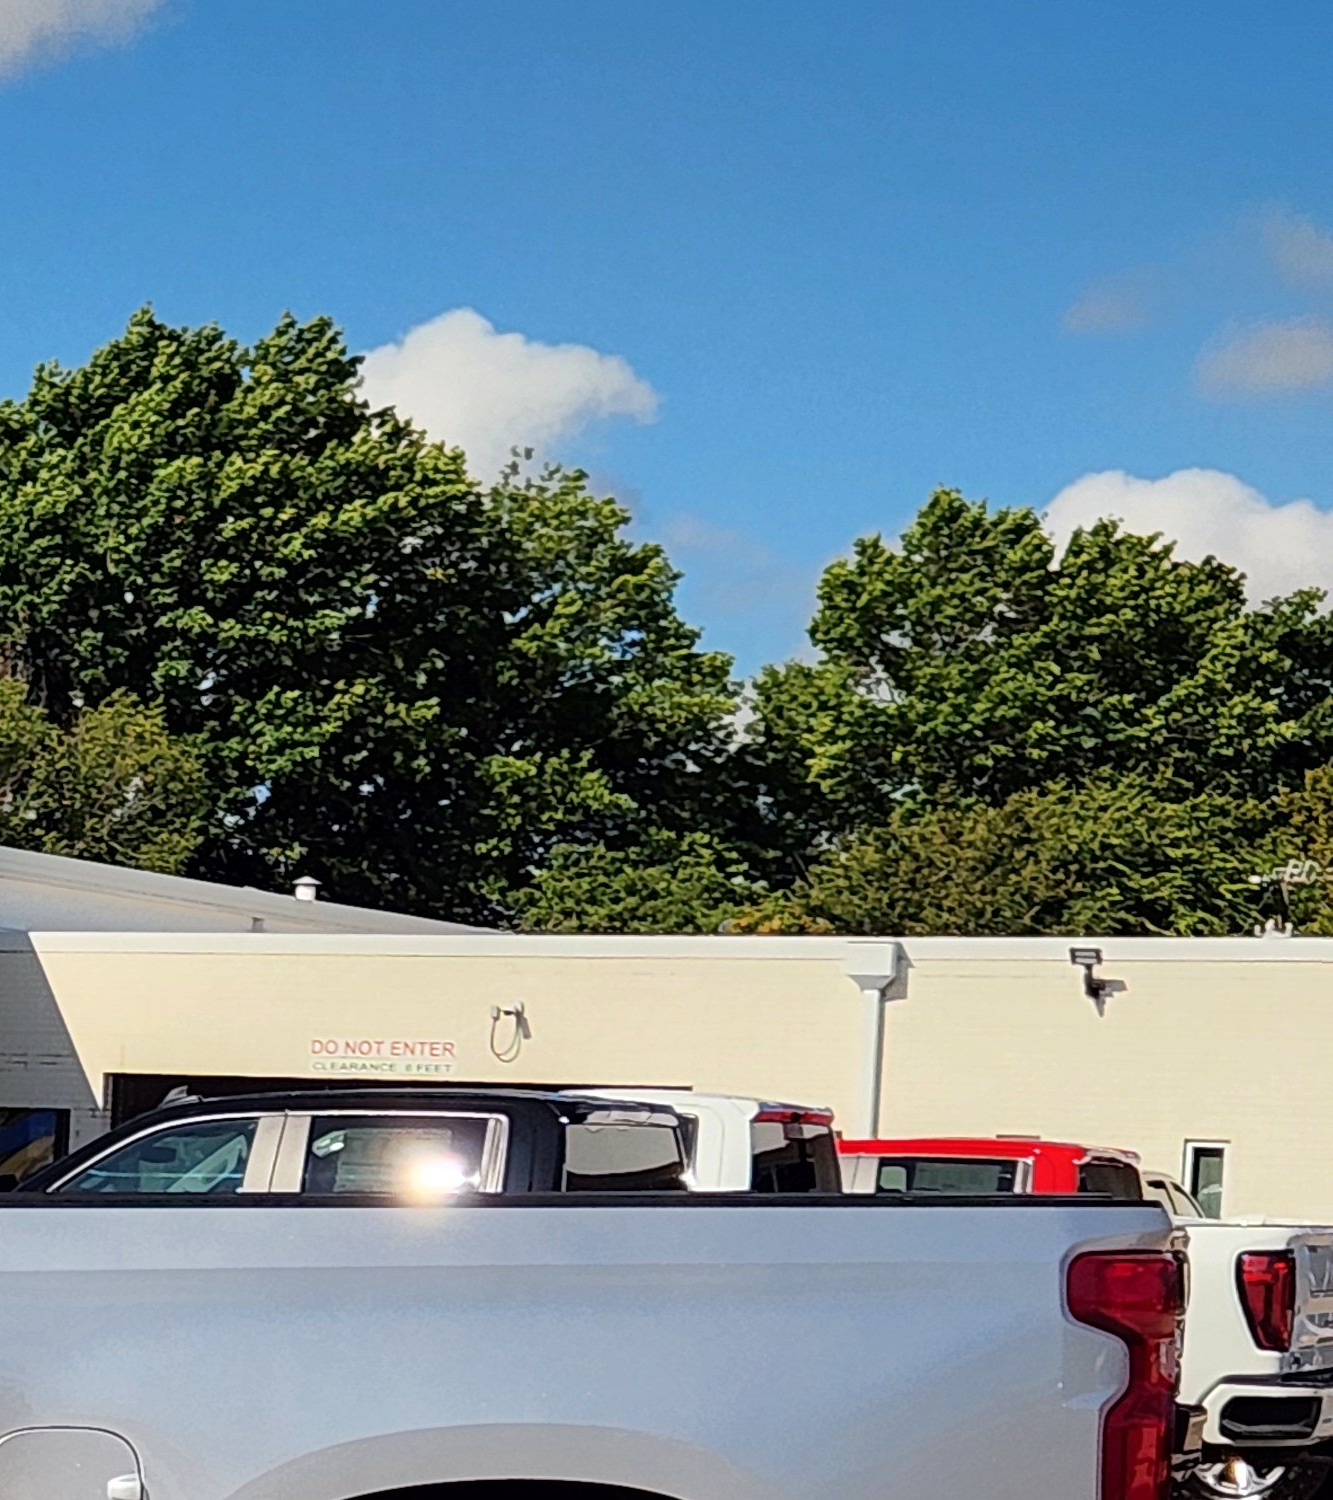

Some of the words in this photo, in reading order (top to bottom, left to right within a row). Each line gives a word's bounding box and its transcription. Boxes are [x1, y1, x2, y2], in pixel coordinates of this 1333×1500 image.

[311, 1039, 339, 1055] DO
[344, 1040, 385, 1056] NOT
[390, 1041, 456, 1057] ENTER
[312, 1062, 396, 1072] CLEARANCE
[417, 1064, 452, 1073] FEET
